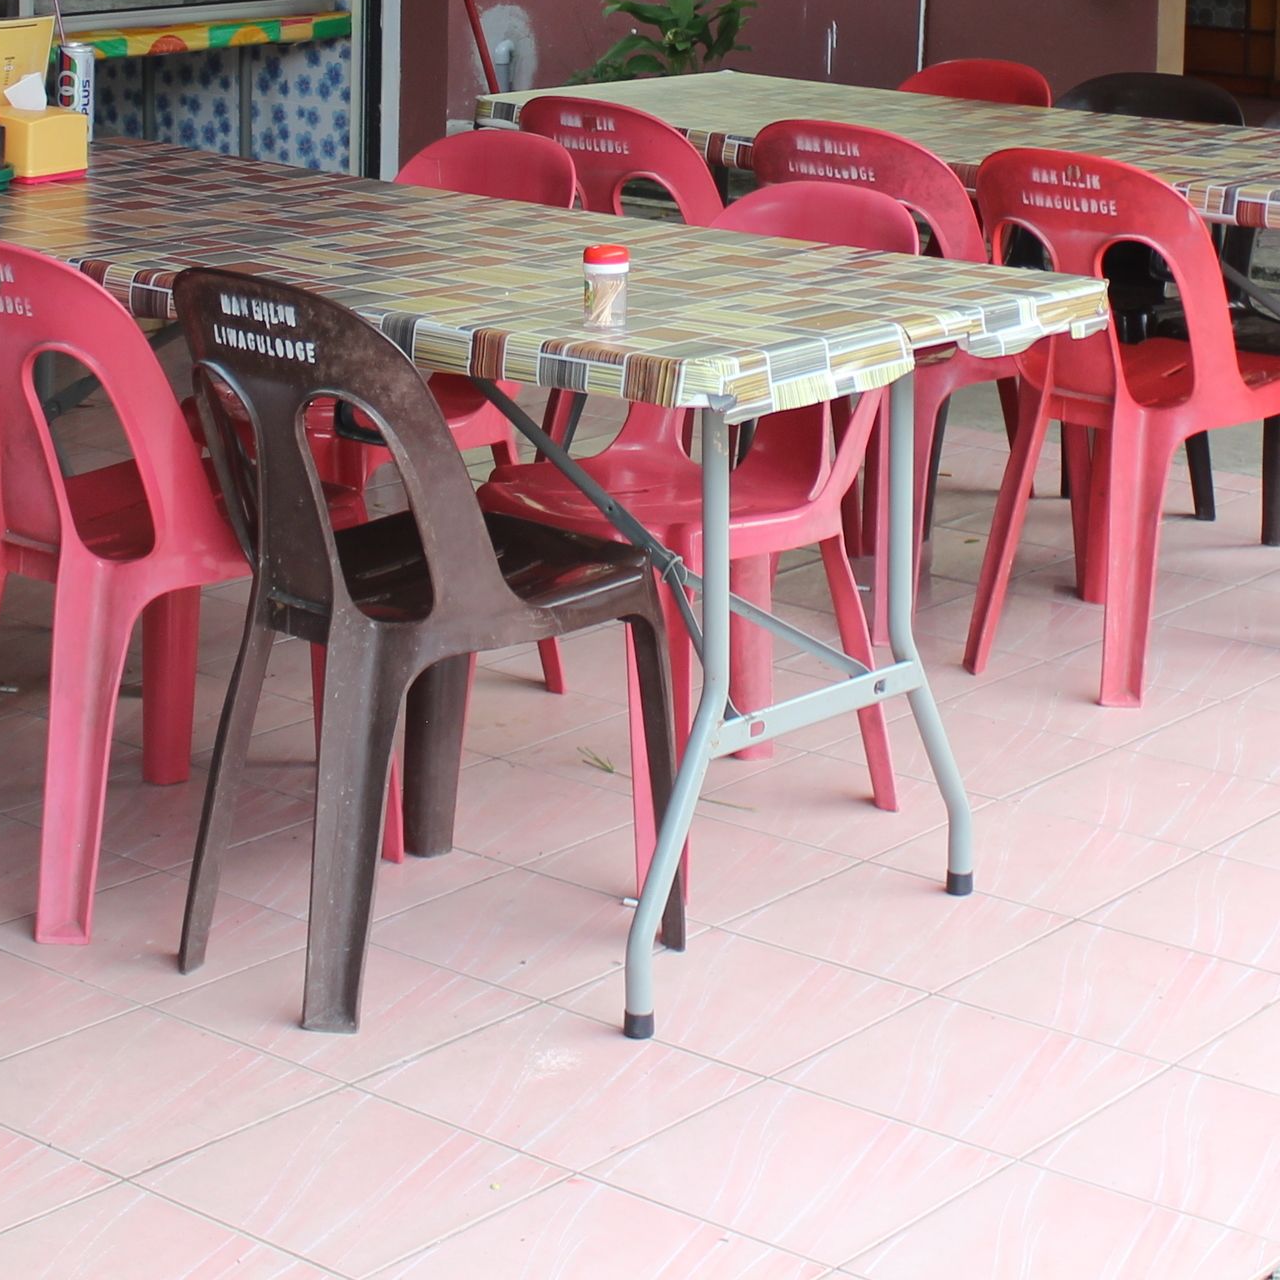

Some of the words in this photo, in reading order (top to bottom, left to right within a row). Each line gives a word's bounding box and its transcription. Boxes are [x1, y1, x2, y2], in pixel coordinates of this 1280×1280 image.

[81, 80, 90, 115] PLUS
[824, 139, 859, 157] MILIK
[1032, 167, 1058, 184] HAK
[1022, 191, 1117, 216] LIWAGULODGE
[214, 323, 315, 363] LIWAGULODGE
